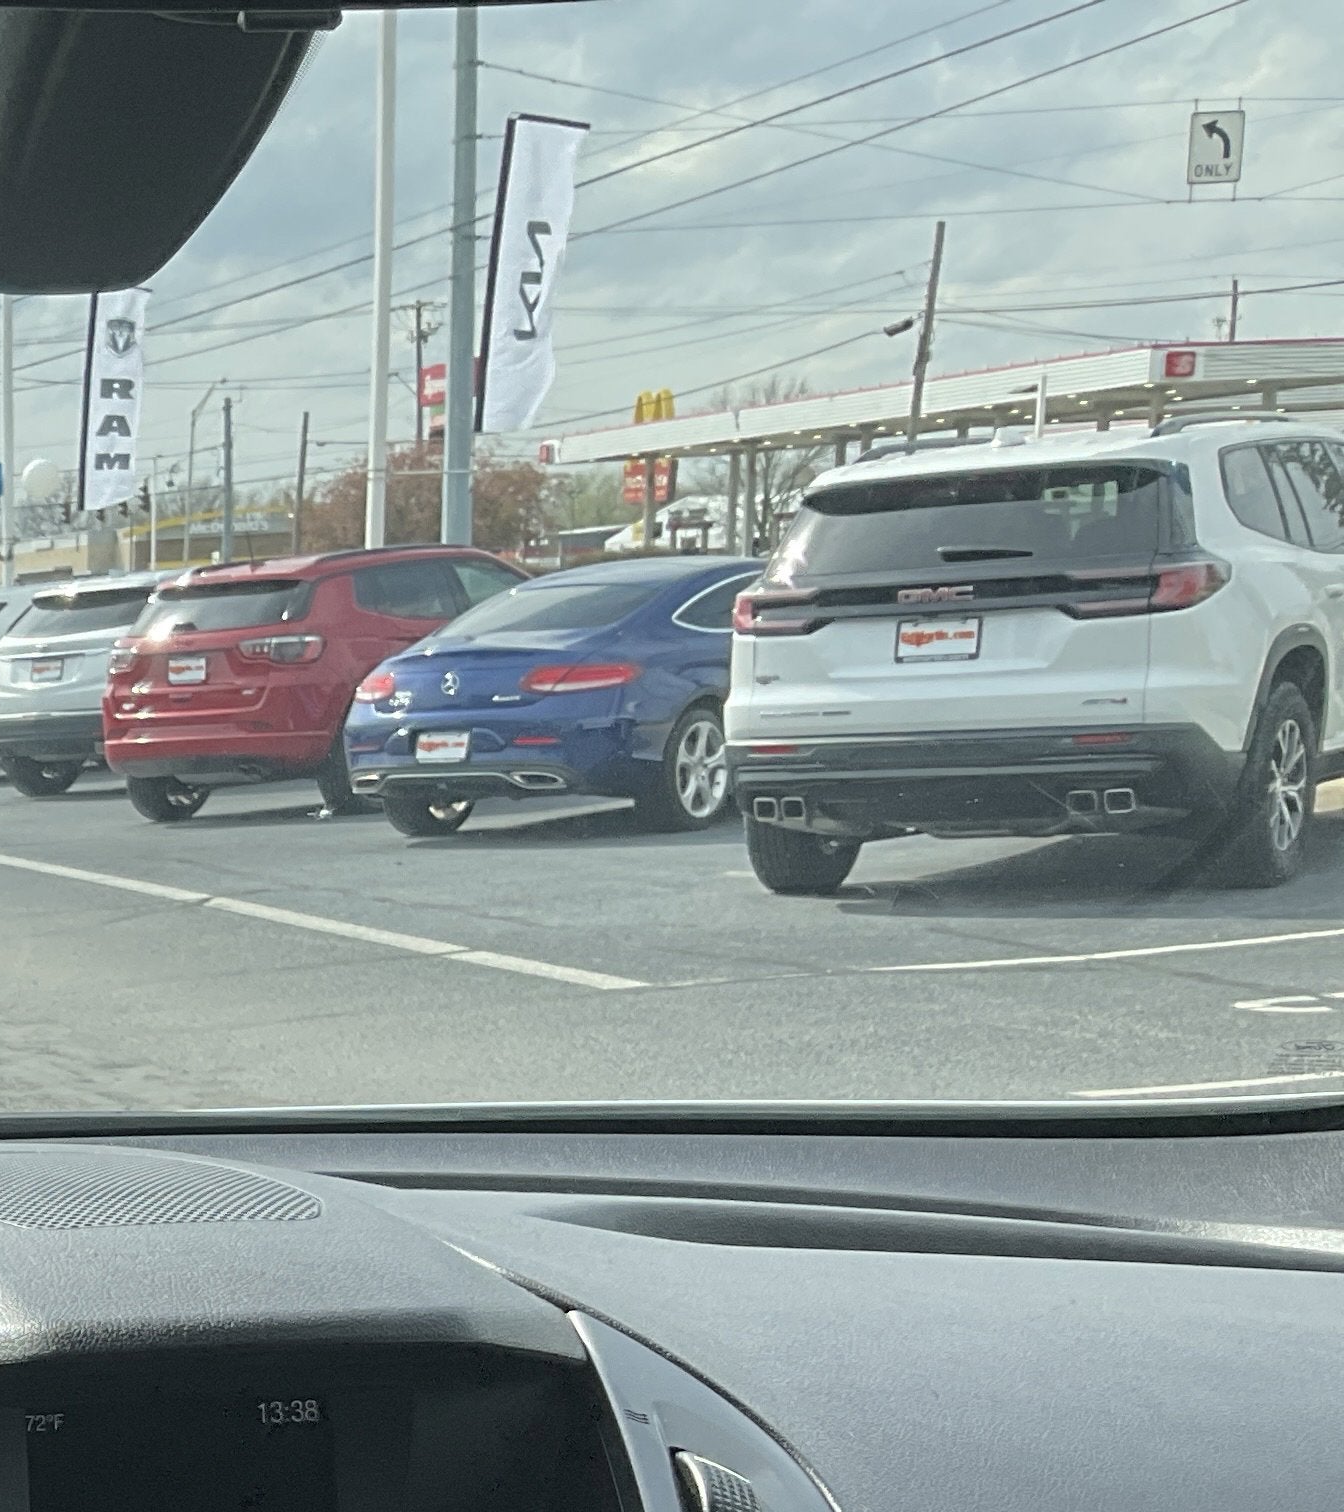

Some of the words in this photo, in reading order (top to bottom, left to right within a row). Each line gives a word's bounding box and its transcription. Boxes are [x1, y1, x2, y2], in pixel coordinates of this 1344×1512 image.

[1193, 161, 1233, 178] ONLY
[94, 379, 135, 470] RAM
[257, 1399, 319, 1424] 13:38
